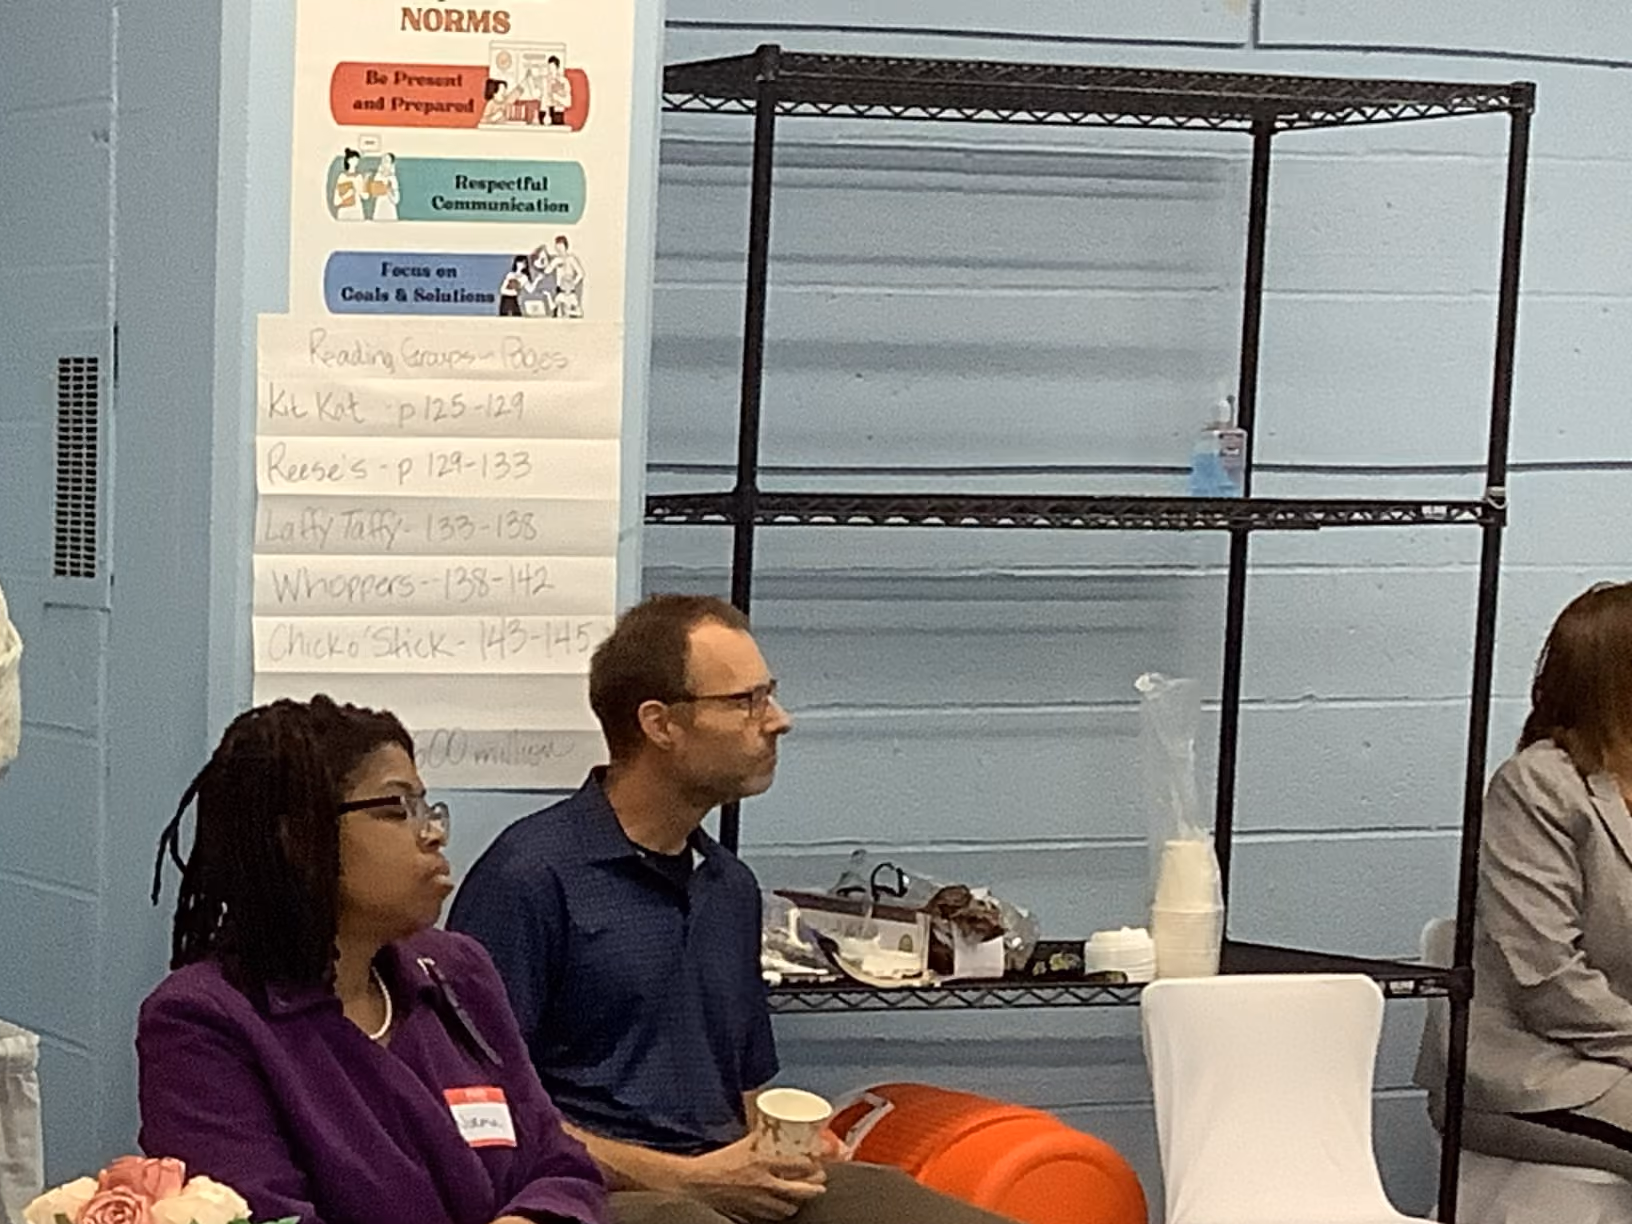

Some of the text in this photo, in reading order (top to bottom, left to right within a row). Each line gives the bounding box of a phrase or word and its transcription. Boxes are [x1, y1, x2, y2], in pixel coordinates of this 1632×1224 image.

[400, 7, 512, 35] NORMS
[366, 70, 462, 87] Be Present
[353, 97, 474, 115] and Prepared
[455, 174, 548, 193] Respectful
[431, 195, 569, 213] Communication
[381, 261, 457, 278] Focus on
[341, 286, 495, 304] Goals & Solutions
[309, 327, 396, 373] Reading
[268, 382, 308, 418] Kit
[317, 391, 366, 424] Kat
[267, 441, 369, 486] Reese's
